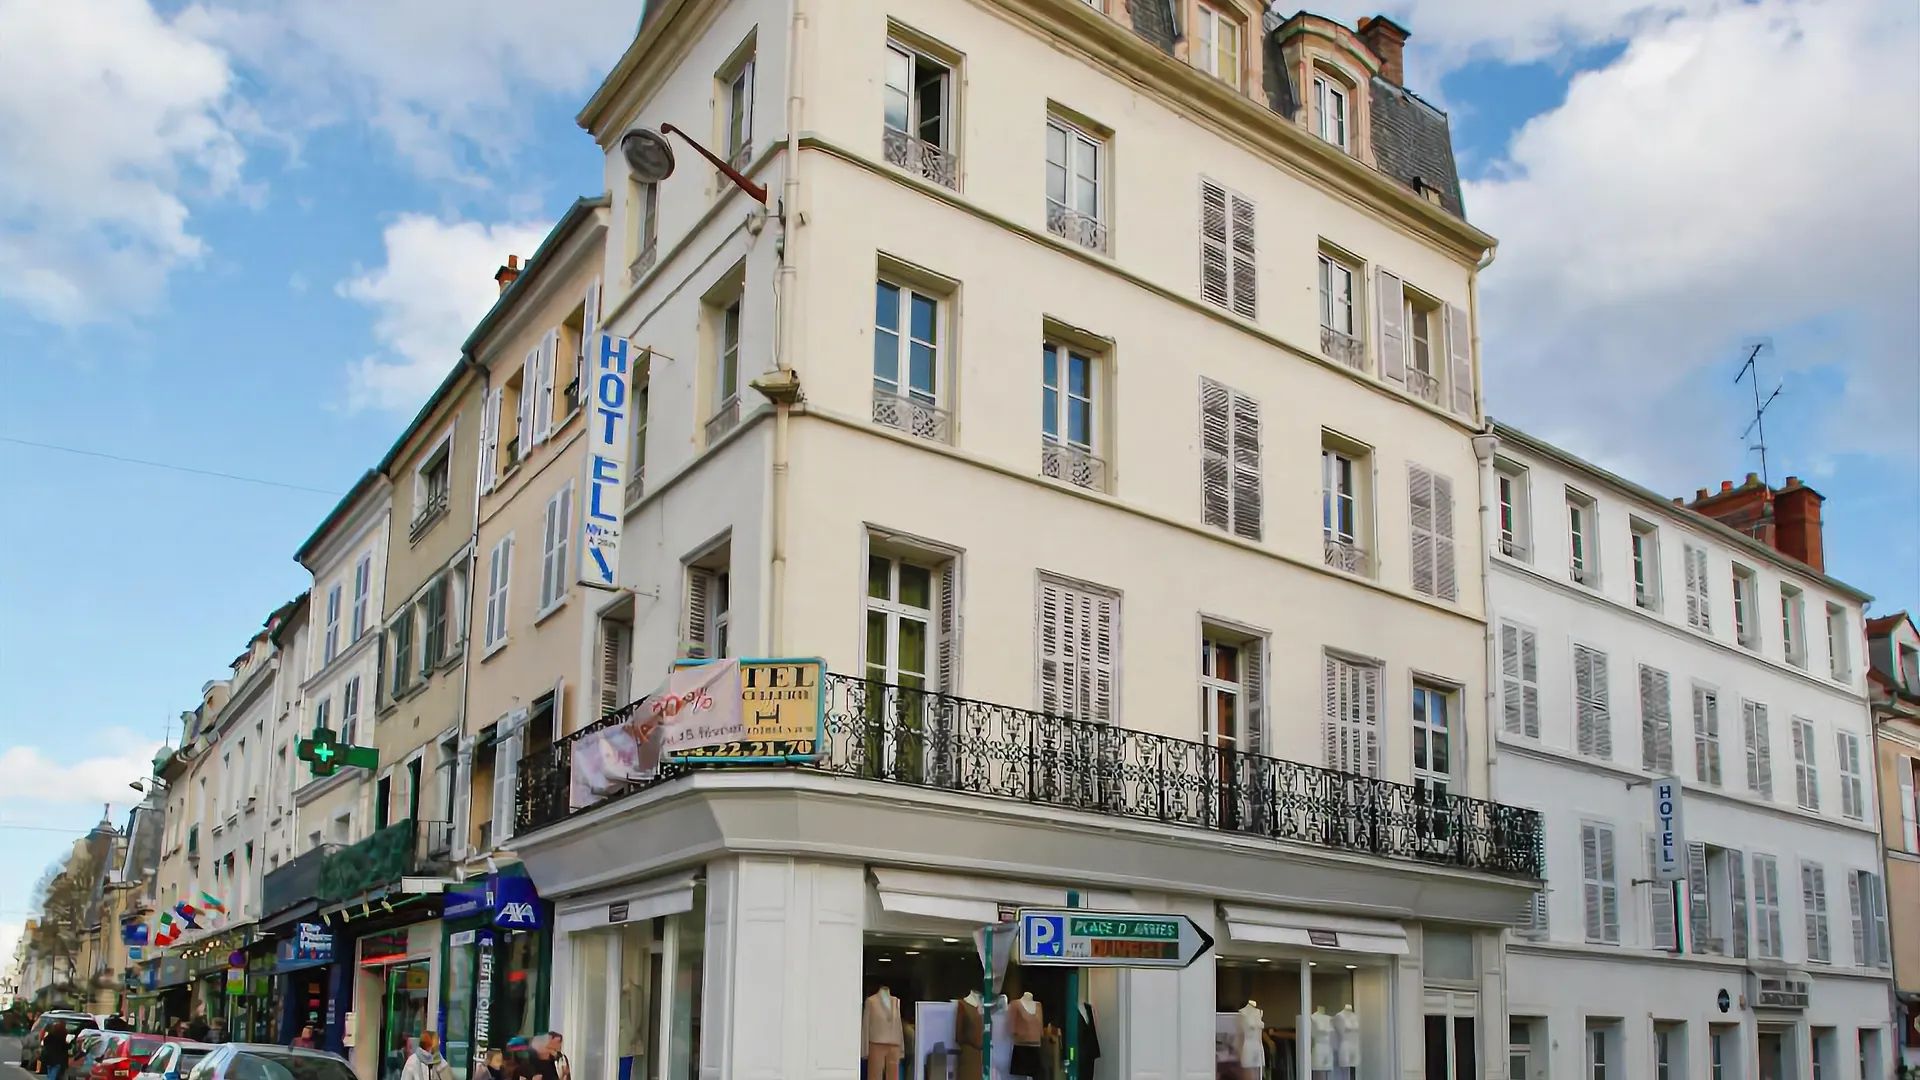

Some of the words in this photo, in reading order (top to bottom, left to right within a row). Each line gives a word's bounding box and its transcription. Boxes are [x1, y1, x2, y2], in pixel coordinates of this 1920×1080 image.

[590, 335, 628, 521] HOTEL
[742, 666, 814, 688] TEL
[1659, 785, 1674, 862] HOTEL
[495, 902, 536, 923] AXA
[1030, 918, 1055, 954] P
[1074, 920, 1113, 936] PLACE
